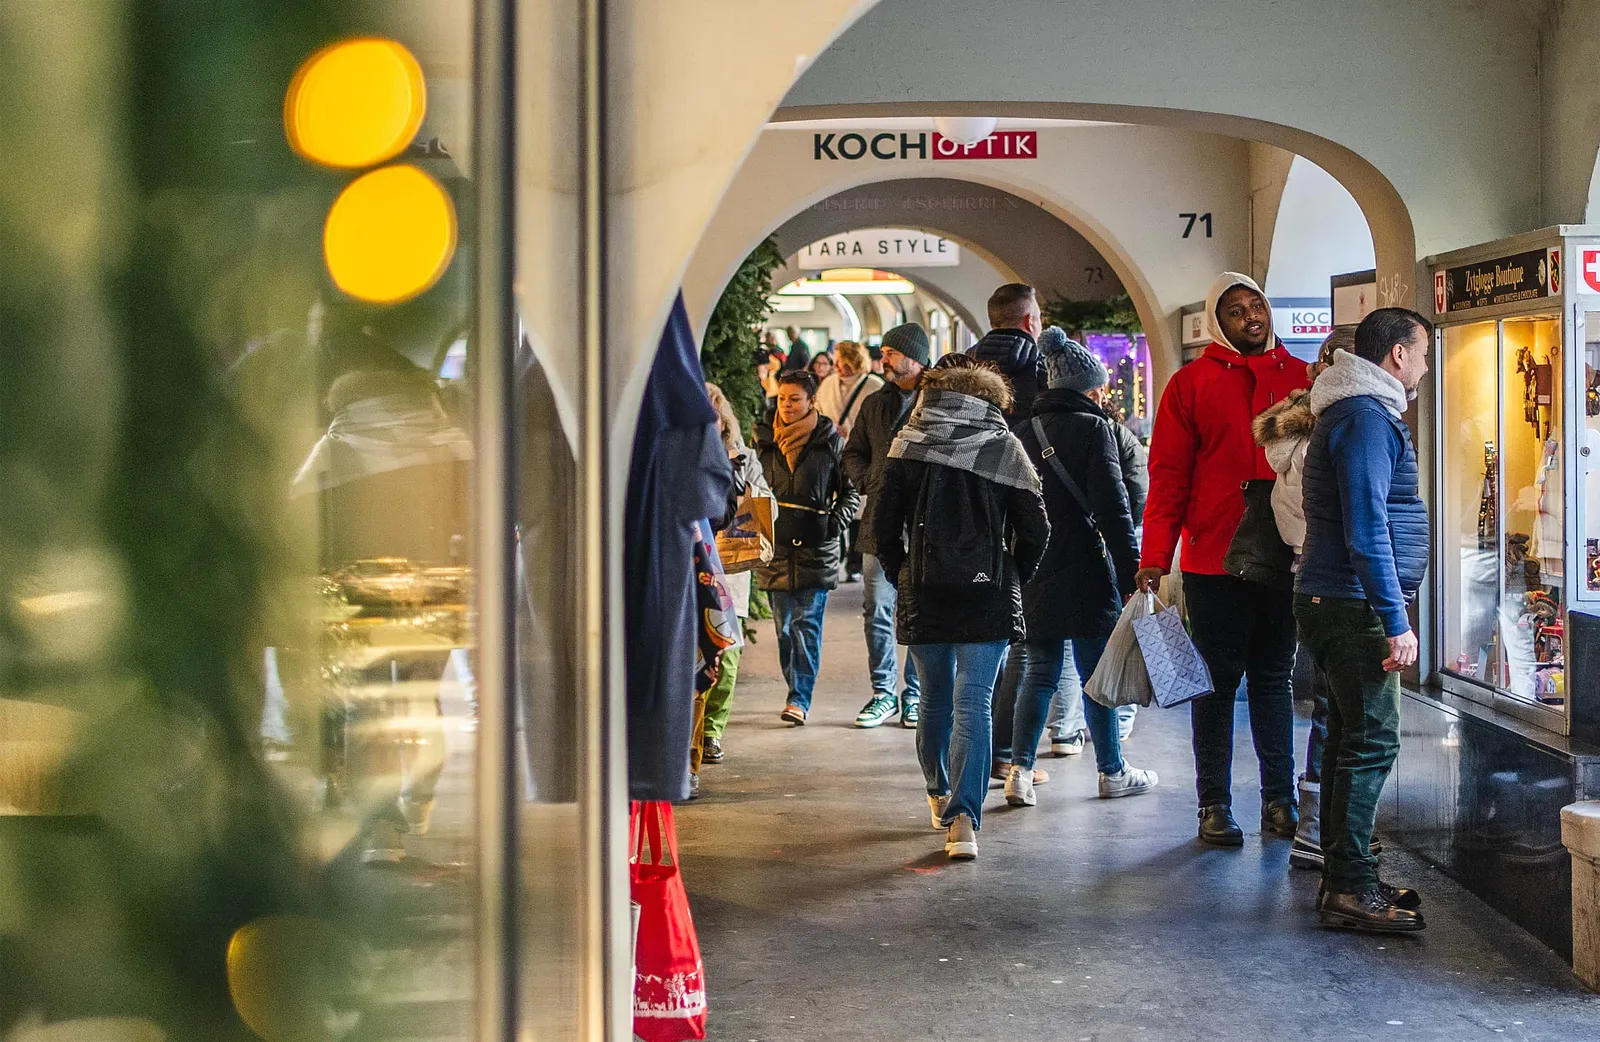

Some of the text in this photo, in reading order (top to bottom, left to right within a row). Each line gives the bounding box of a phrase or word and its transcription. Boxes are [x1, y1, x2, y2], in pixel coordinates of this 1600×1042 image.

[814, 133, 1032, 160] KOCH OPTIK
[1179, 212, 1212, 239] 71
[878, 239, 946, 254] STYLE
[1084, 267, 1103, 284] 73
[1495, 262, 1524, 290] Boutique
[1292, 312, 1329, 324] KOC
